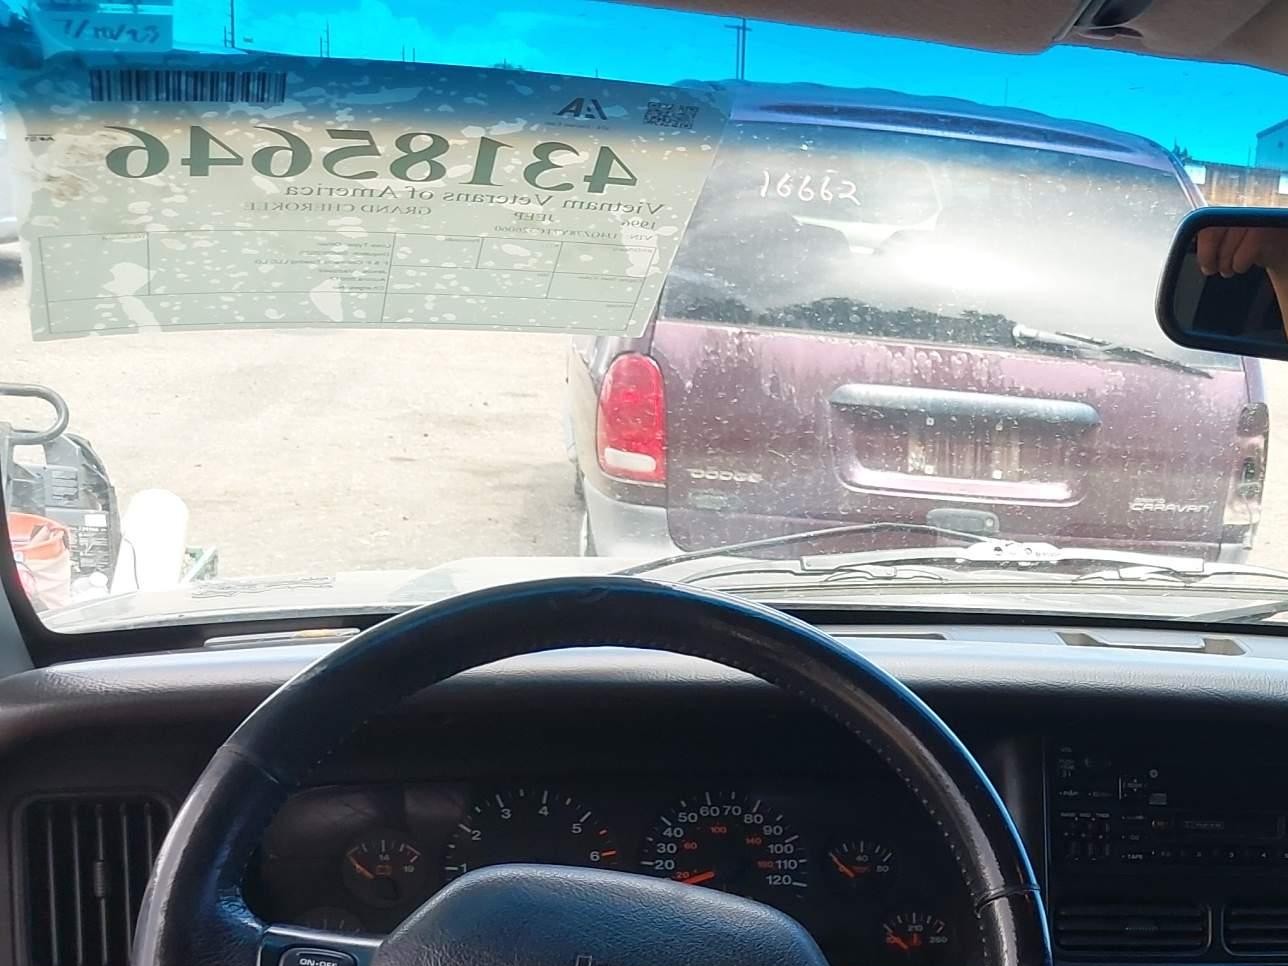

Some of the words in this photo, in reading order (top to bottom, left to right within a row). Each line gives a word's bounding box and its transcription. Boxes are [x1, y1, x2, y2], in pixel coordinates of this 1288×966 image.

[760, 170, 861, 206] 16662
[1130, 502, 1210, 512] CARAVAN
[501, 808, 512, 819] 3
[539, 806, 550, 817] 4
[700, 806, 720, 817] 60
[722, 805, 742, 816] 70
[679, 812, 699, 824] 50
[743, 813, 764, 825] 80
[572, 823, 582, 834] 5
[663, 827, 684, 839] 40
[763, 825, 783, 836] 90
[472, 829, 482, 840] 2
[657, 842, 678, 854] 30
[768, 843, 794, 855] 100
[590, 850, 600, 862] 6
[655, 859, 676, 871] 20
[777, 859, 799, 870] 110
[766, 875, 793, 886] 120
